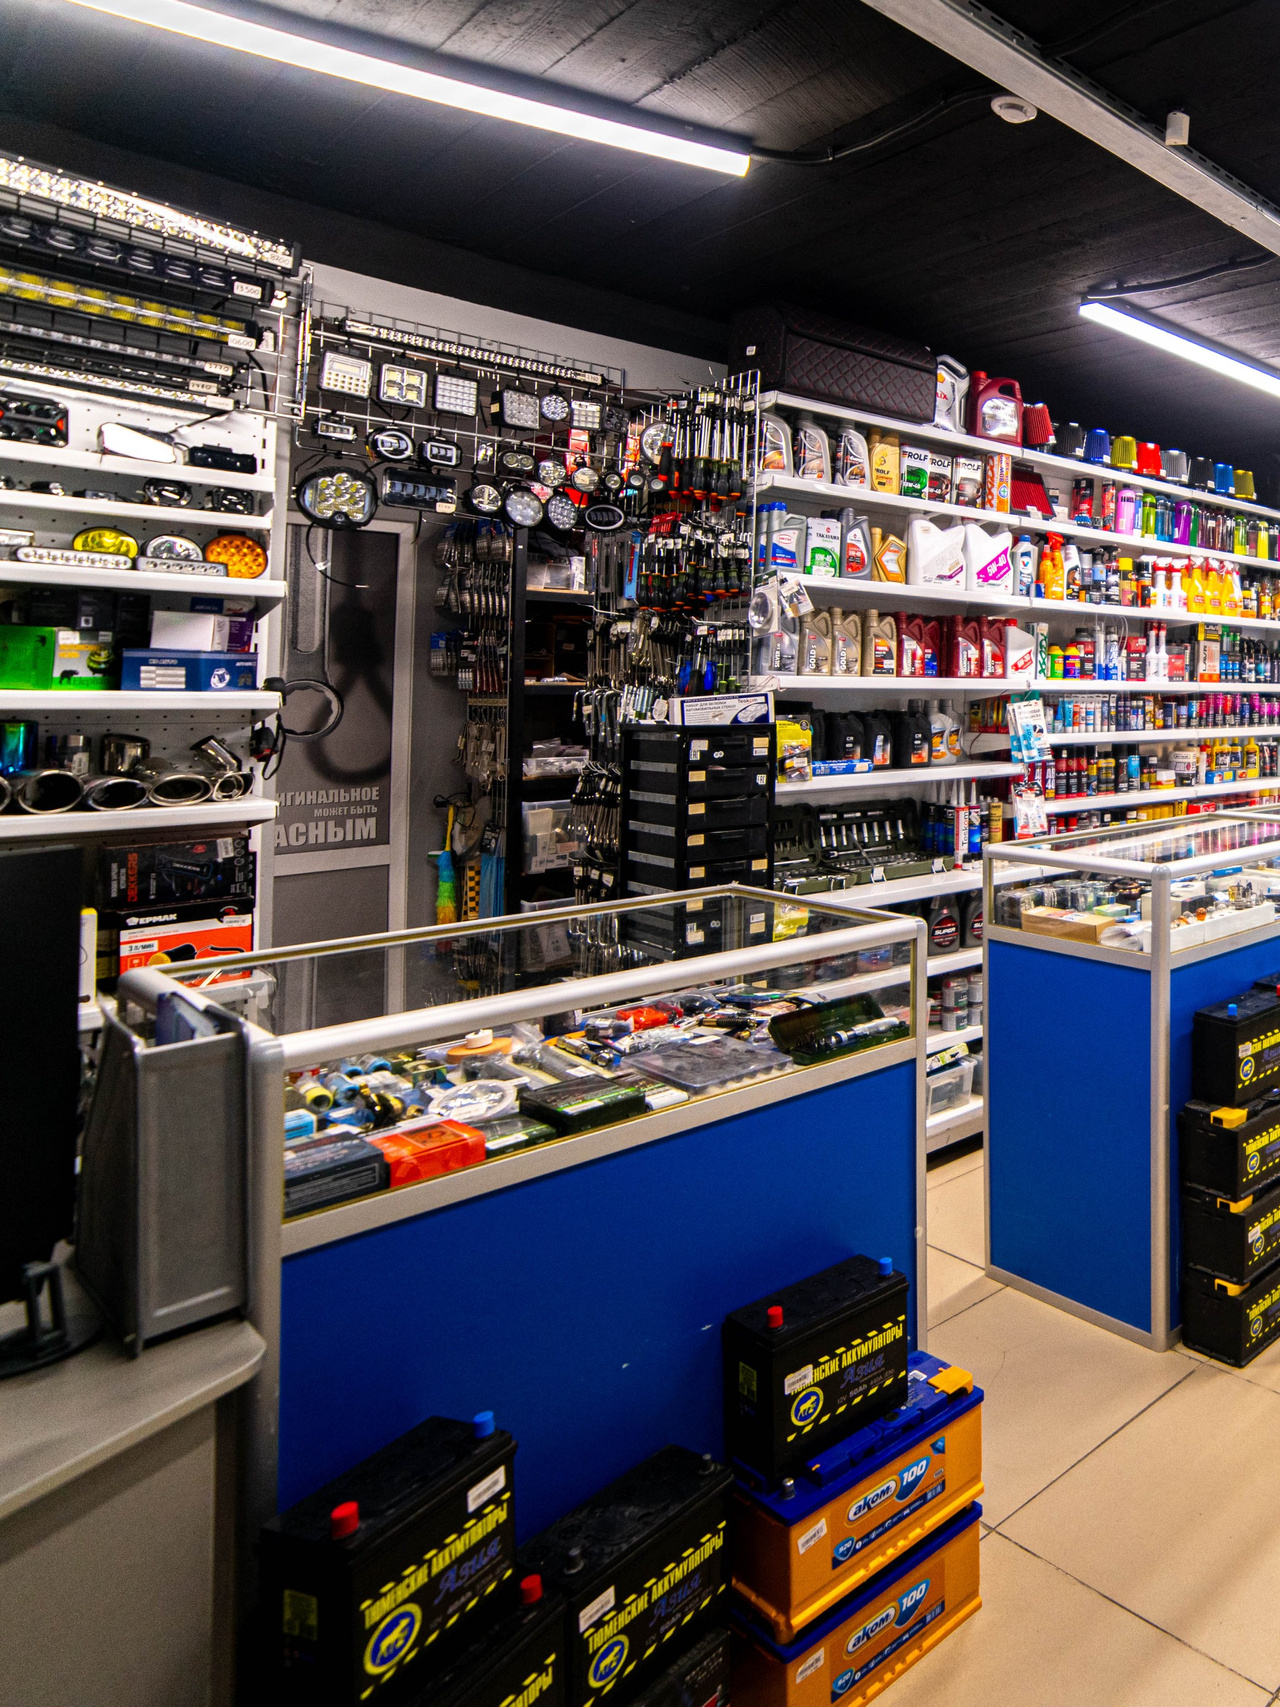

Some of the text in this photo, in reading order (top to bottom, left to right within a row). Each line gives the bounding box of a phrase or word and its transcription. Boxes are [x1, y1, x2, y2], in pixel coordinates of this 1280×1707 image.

[230, 336, 253, 347] 10600
[908, 451, 928, 461] ROLF
[931, 458, 951, 468] ROLF
[961, 462, 981, 471] ROLF
[987, 554, 1006, 577] 5W-40
[314, 805, 378, 817] МОЖЕТ БЫТЬ
[274, 817, 376, 848] АСНЫМ
[127, 852, 138, 902] DEKKERS
[139, 914, 177, 925] ЕРМАК
[934, 927, 956, 936] SUPER
[790, 1323, 903, 1396] ЕНСКИЕ АККУМУЛЯТОРЫ
[849, 1384, 868, 1398] 50Ah
[902, 1459, 927, 1487] 100
[853, 1484, 891, 1517] akom
[364, 1562, 429, 1630] ТЮМЕНСКИЕ
[431, 1501, 508, 1578] АККУМУЛЯТОРЫ
[588, 1530, 724, 1655] ТЮМЕНСКИЕ АККУМУЛЯТОРЫ
[902, 1583, 927, 1612] 100
[852, 1612, 890, 1649] akom
